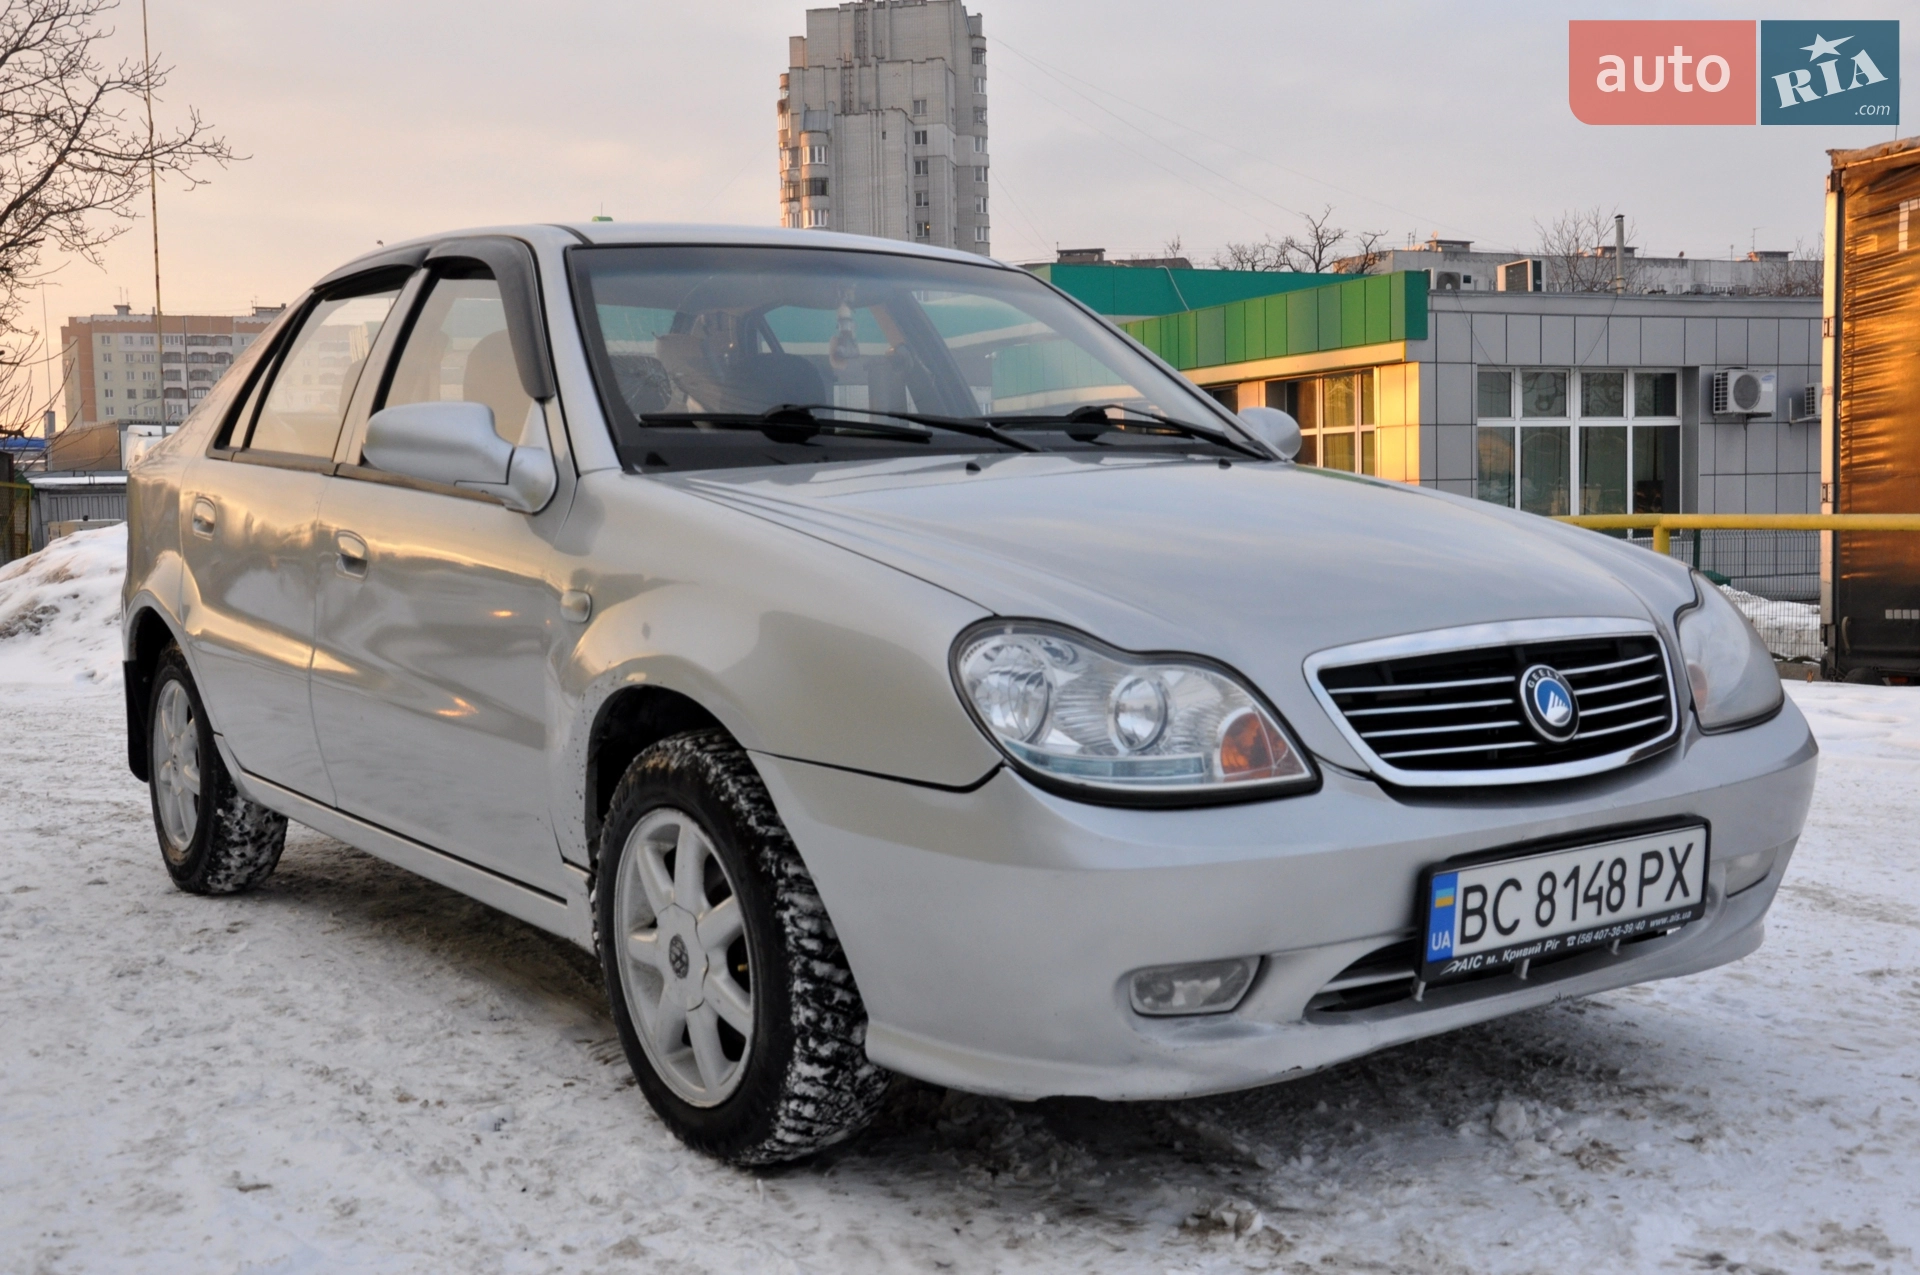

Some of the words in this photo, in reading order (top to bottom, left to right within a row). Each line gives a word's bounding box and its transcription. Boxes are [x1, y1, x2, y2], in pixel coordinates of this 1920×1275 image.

[1459, 878, 1522, 945] BC
[1535, 857, 1627, 928] 8148
[1637, 842, 1694, 908] PX
[1432, 930, 1451, 951] UA
[1503, 943, 1542, 963] Кривий
[1545, 939, 1561, 952] Ріг
[1650, 910, 1693, 928] www.ais.ua
